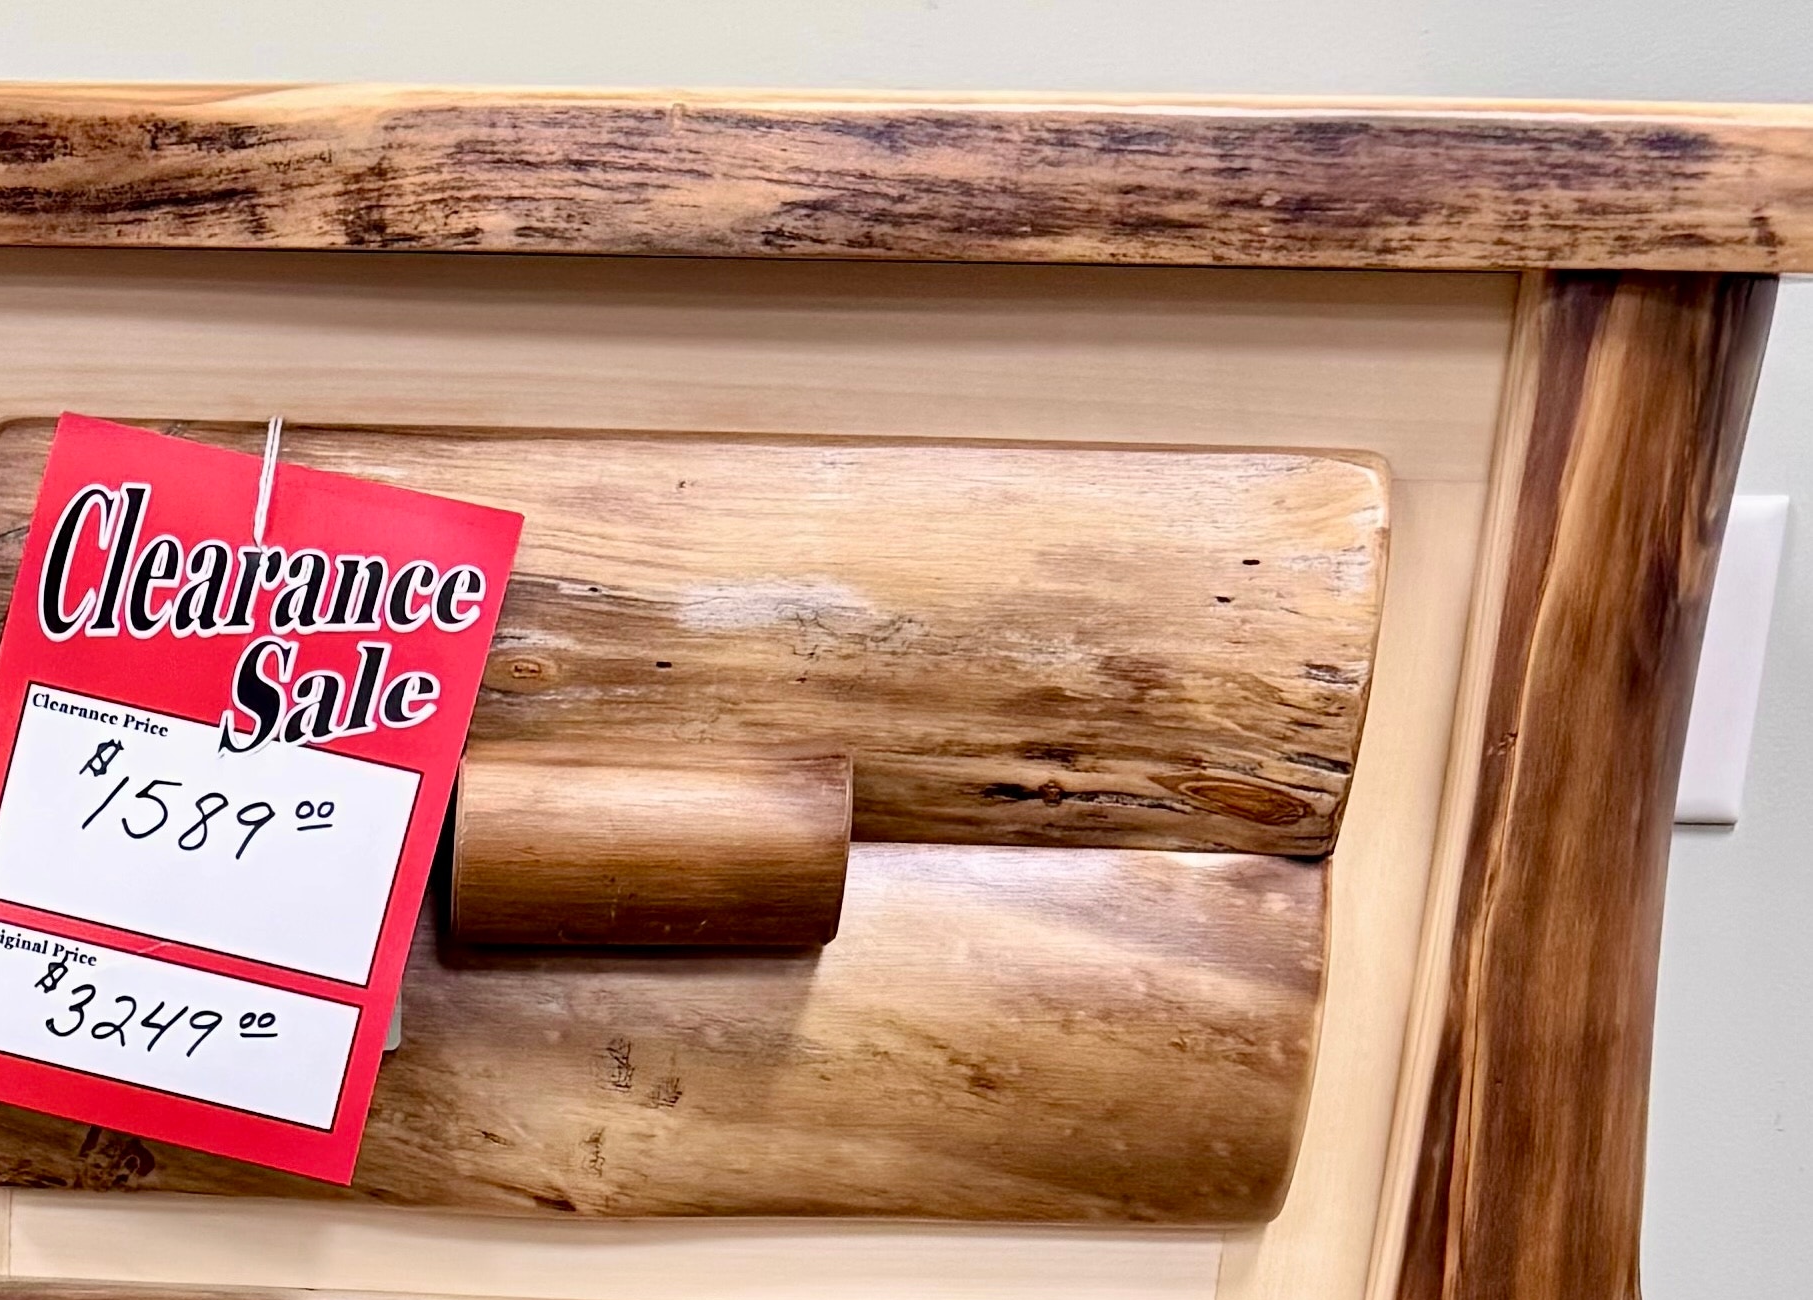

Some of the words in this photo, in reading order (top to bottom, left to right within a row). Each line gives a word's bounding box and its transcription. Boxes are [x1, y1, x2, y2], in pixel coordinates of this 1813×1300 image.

[39, 482, 486, 640] Clearance
[31, 692, 119, 727] Clearance
[120, 711, 169, 739] Price
[218, 633, 441, 757] Sale
[52, 942, 97, 967] Price
